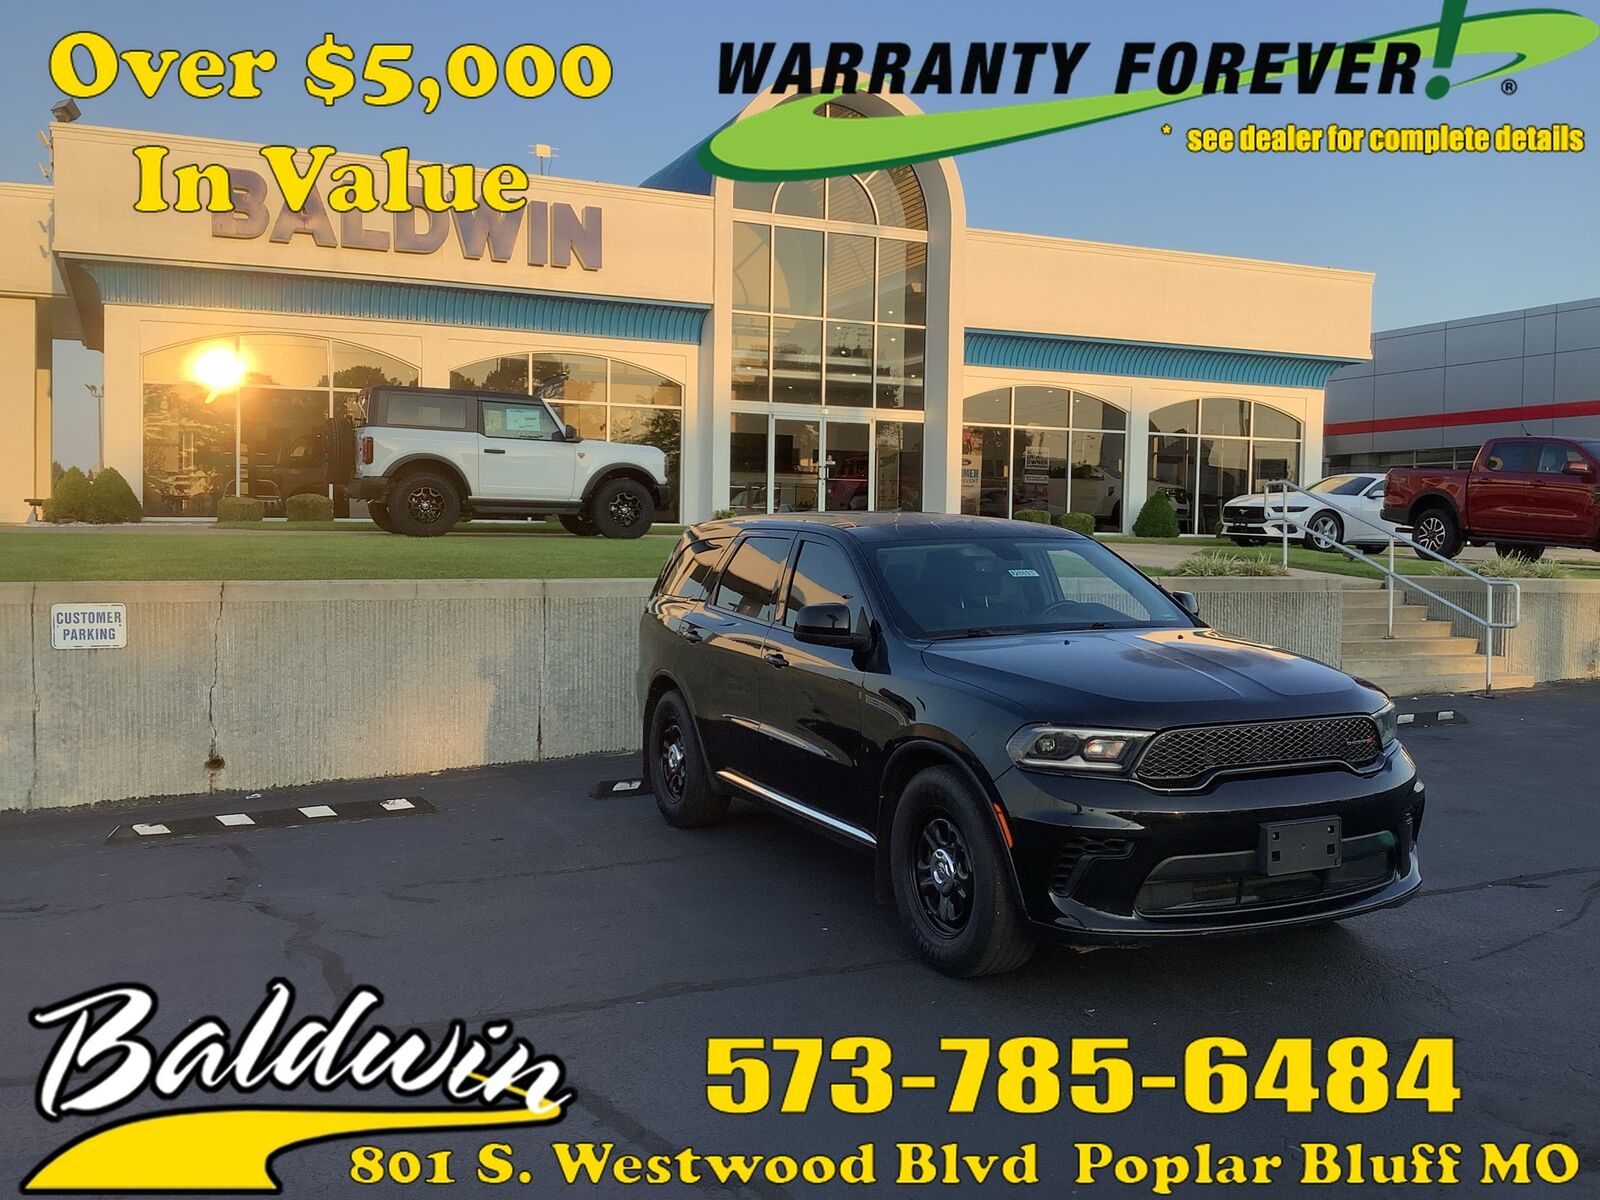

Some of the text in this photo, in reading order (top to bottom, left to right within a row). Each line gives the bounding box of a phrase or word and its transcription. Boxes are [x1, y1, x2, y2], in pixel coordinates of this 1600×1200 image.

[211, 167, 603, 271] BALDWIN
[56, 611, 122, 624] CUSTOMER
[63, 628, 116, 640] PARKING
